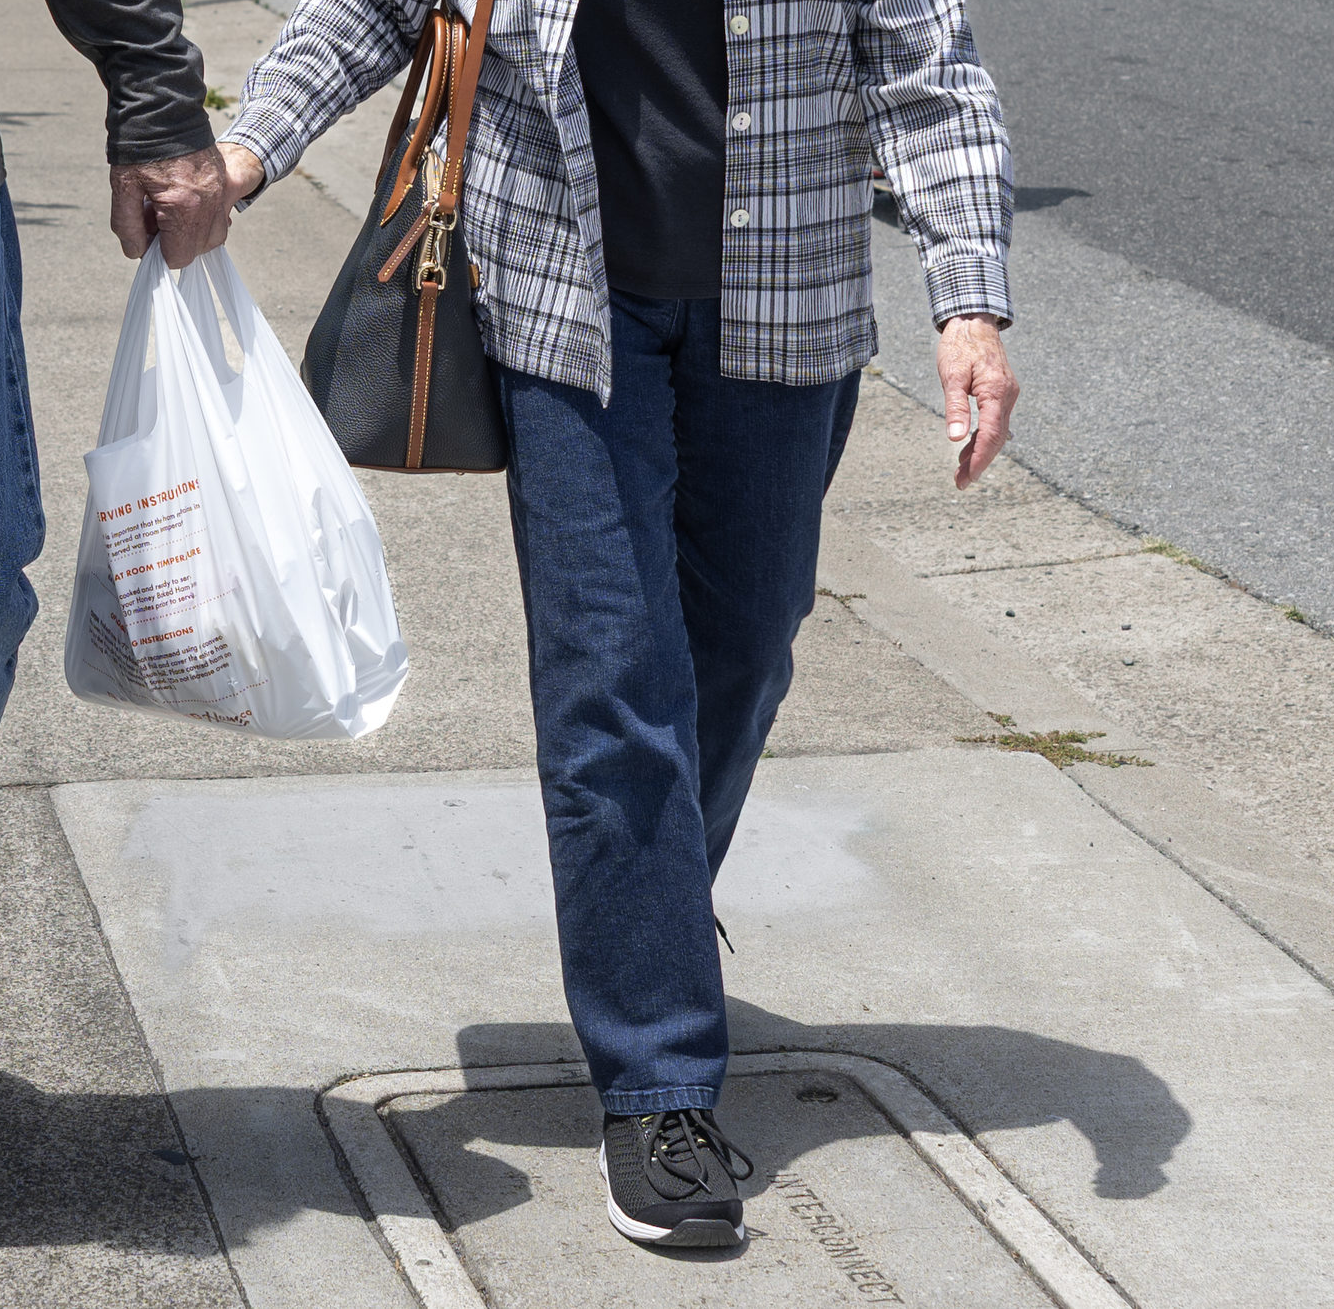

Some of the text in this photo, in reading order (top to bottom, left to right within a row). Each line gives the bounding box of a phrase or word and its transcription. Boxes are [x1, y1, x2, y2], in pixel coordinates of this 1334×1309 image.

[112, 524, 139, 539] important
[141, 520, 153, 529] that
[177, 506, 193, 518] rtains
[114, 534, 133, 548] served
[143, 526, 159, 538] room
[112, 545, 131, 558] served
[114, 572, 125, 582] AT
[126, 564, 154, 577] ROOM
[119, 587, 141, 600] cooked
[141, 584, 154, 593] and
[180, 574, 192, 583] ser
[121, 599, 135, 610] your
[136, 594, 155, 604] Honey
[175, 585, 191, 594] Ham
[122, 609, 132, 618] 30
[139, 626, 195, 645] INSTRUCTIONS
[181, 645, 198, 655] using
[171, 658, 187, 667] cover
[188, 654, 198, 662] the
[186, 661, 209, 673] covered
[208, 654, 224, 665] ham
[767, 1173, 905, 1304] INTERCONNECT
